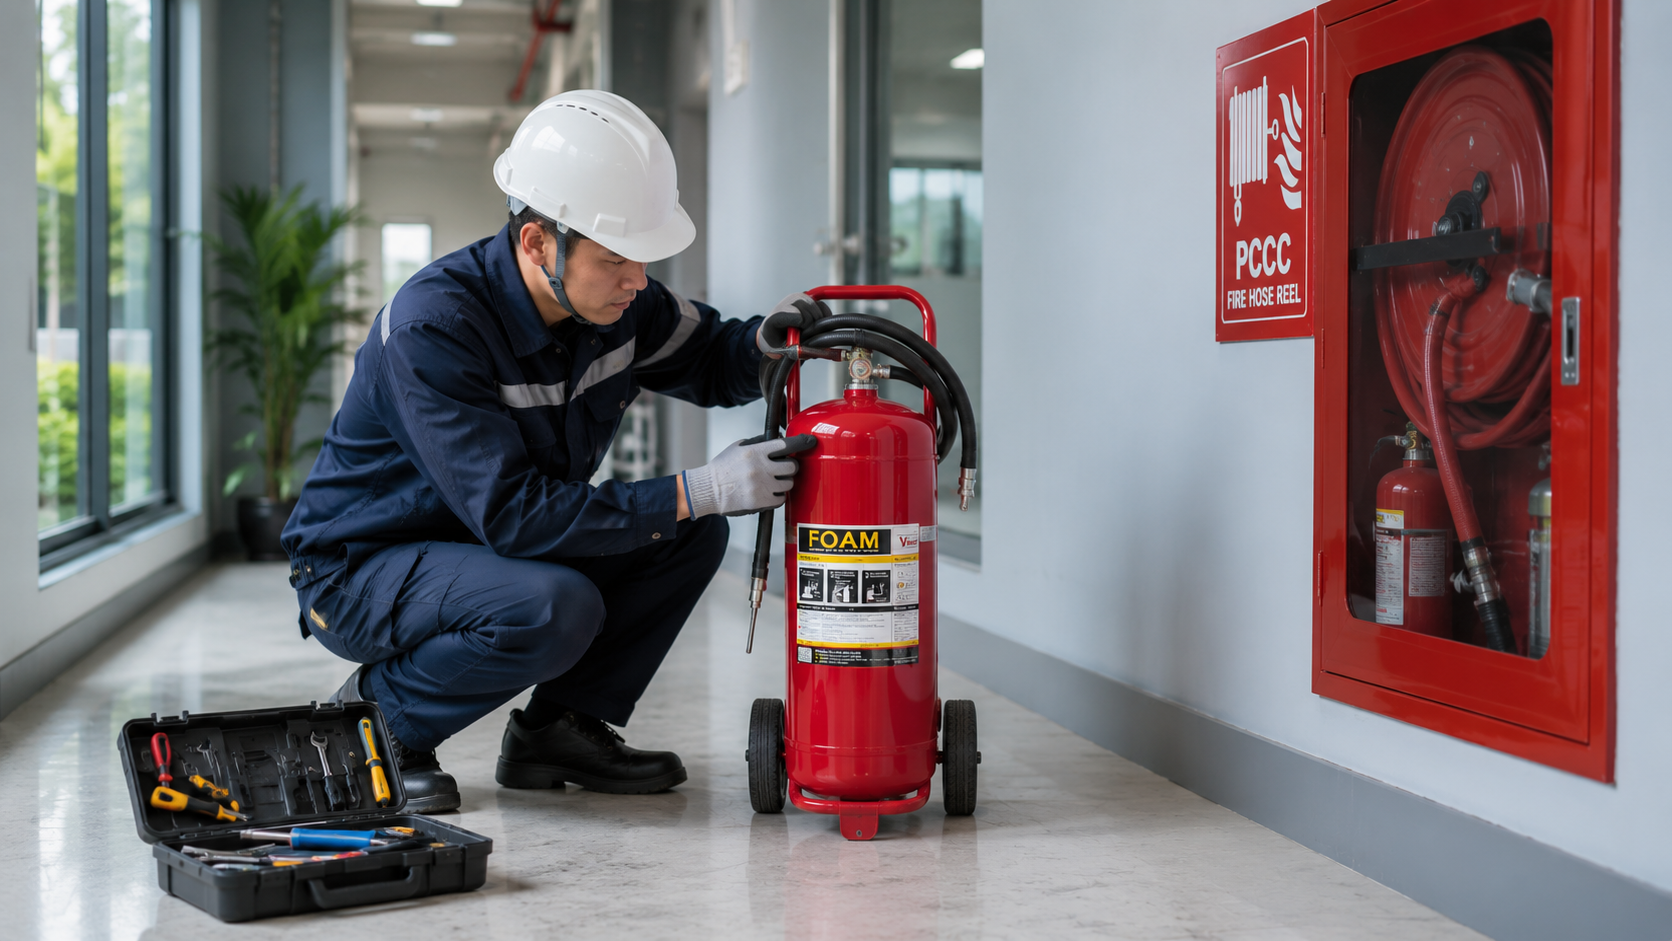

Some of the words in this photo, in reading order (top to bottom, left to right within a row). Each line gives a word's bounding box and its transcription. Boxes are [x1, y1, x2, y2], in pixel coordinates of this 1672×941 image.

[1236, 232, 1291, 280] PCCC
[1227, 289, 1246, 309] FIRE
[1249, 286, 1274, 308] HOSE
[1277, 283, 1301, 304] REEL
[808, 530, 879, 549] FOAM
